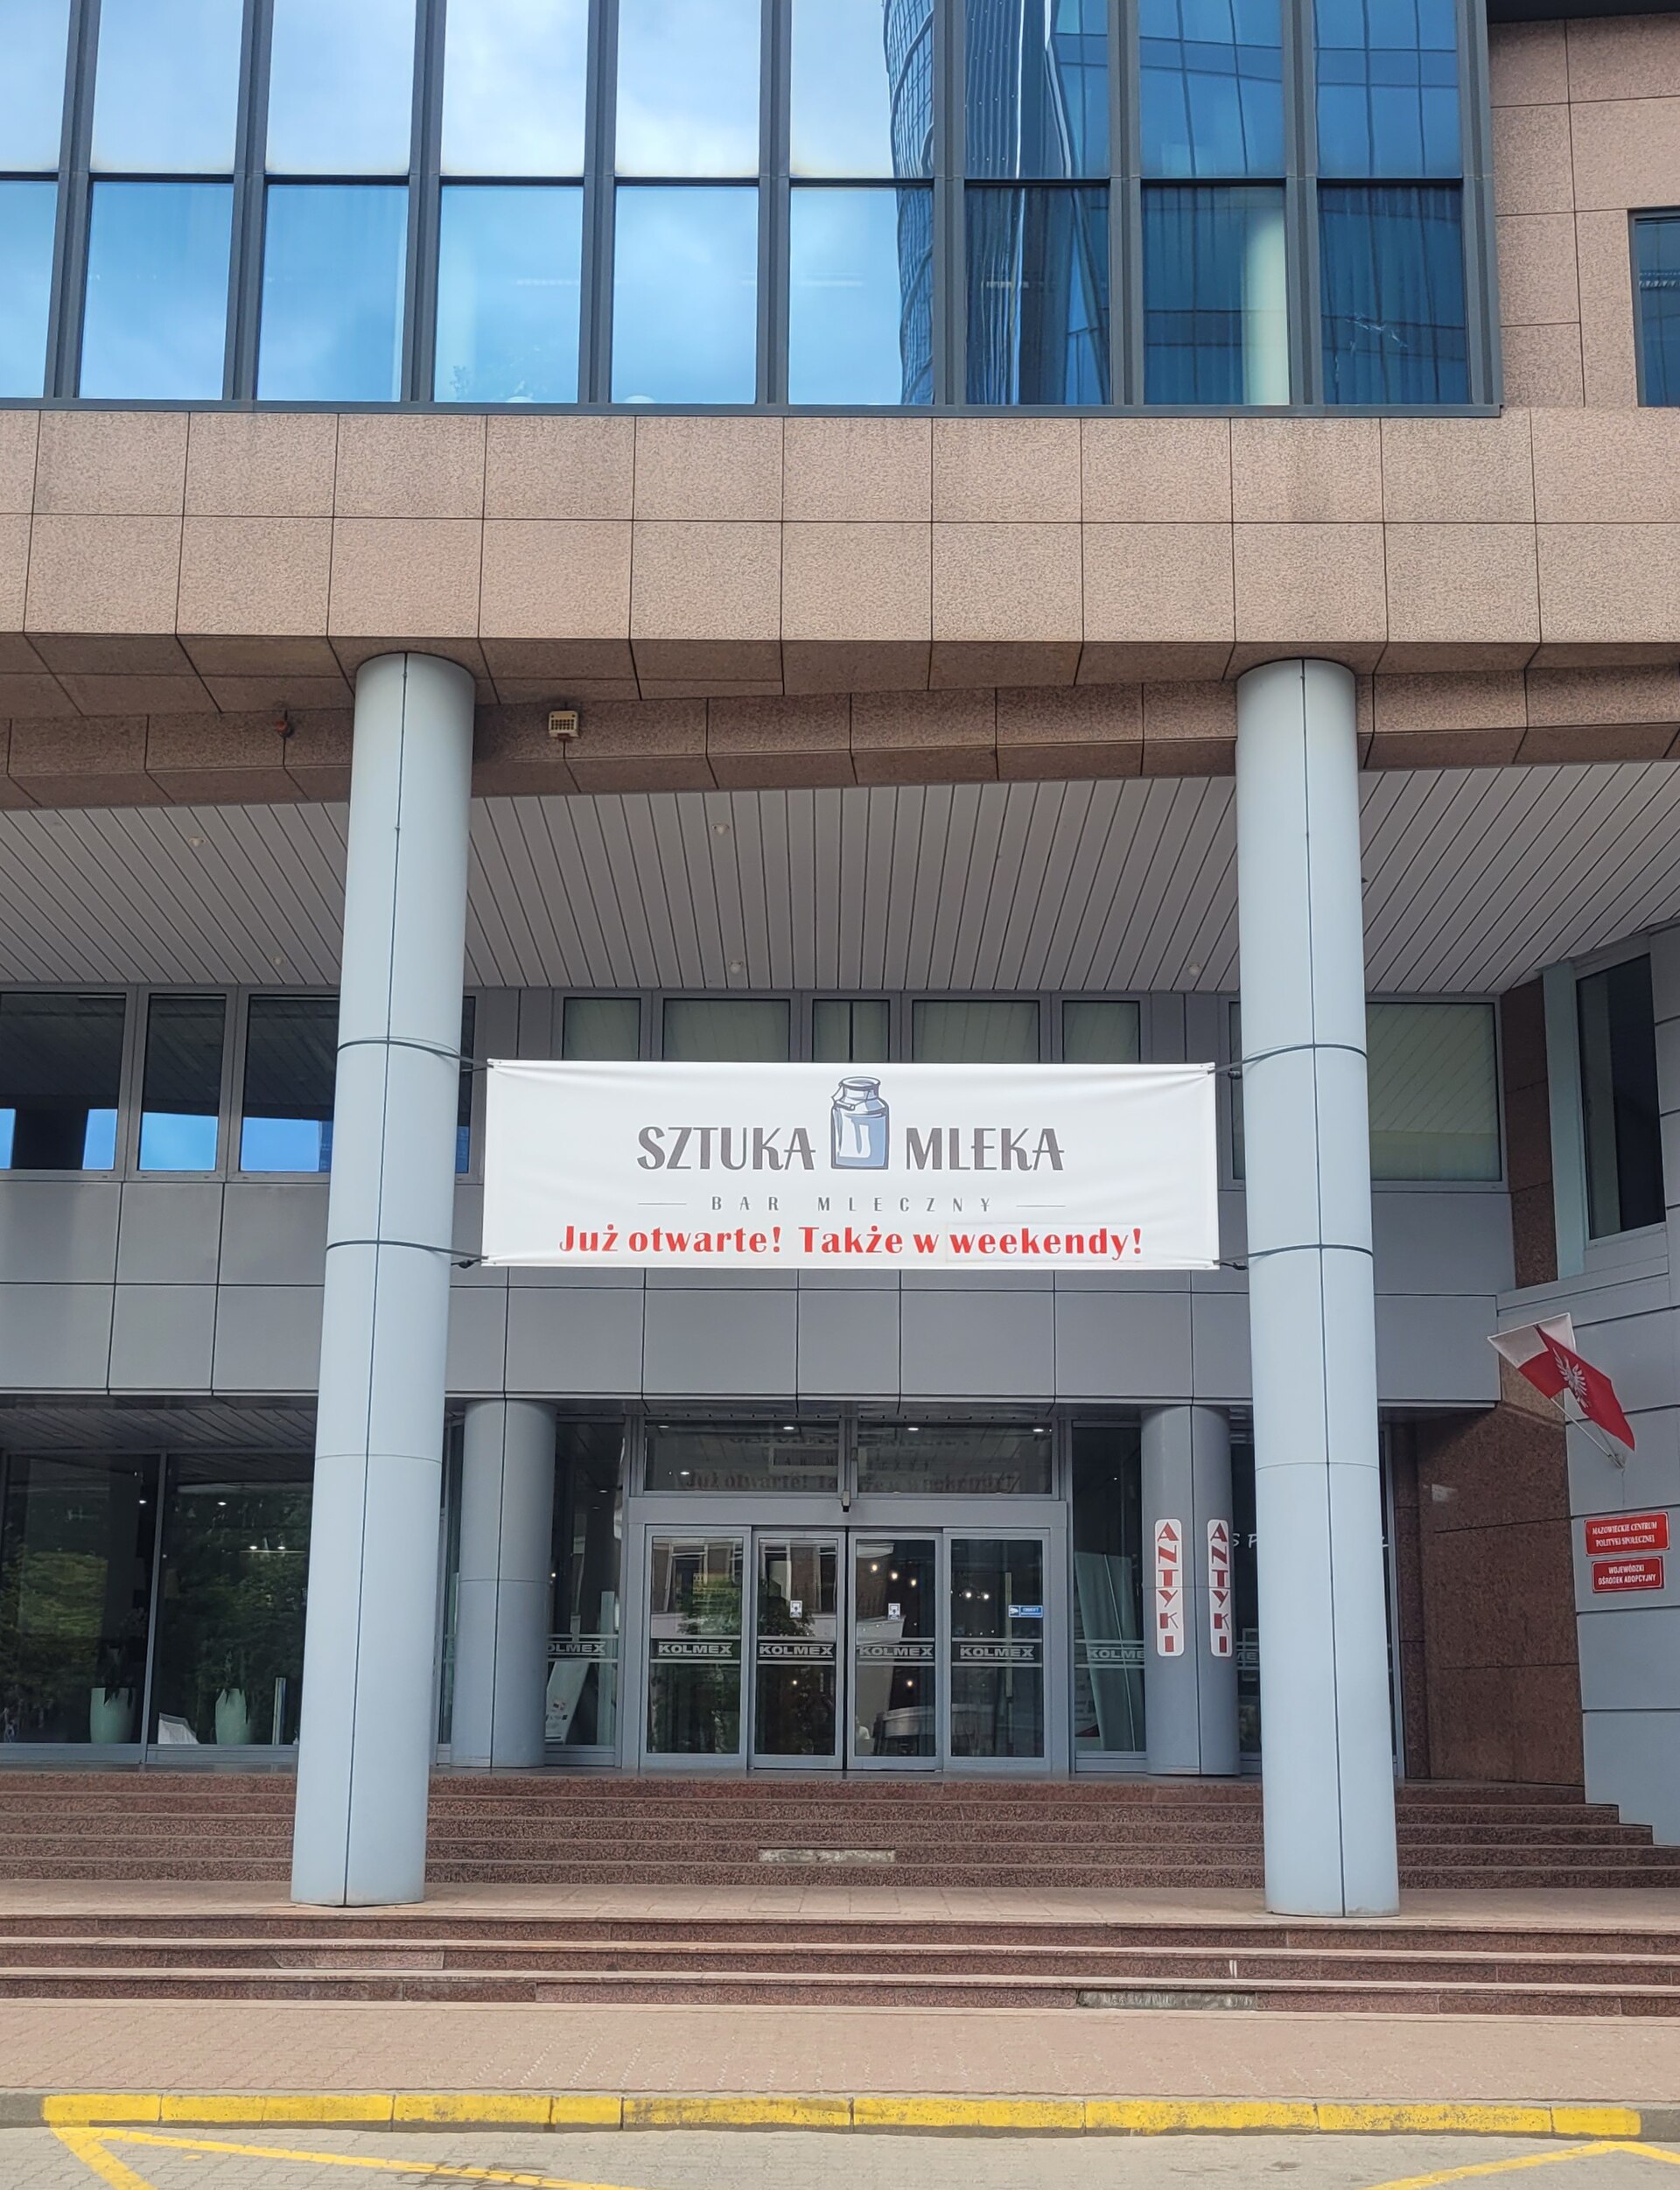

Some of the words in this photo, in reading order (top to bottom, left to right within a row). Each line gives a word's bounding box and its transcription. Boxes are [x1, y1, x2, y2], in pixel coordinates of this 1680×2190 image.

[637, 1126, 816, 1171] SZTUKA
[906, 1128, 1065, 1171] MLEKA
[711, 1196, 780, 1211] BAR
[817, 1197, 992, 1212] MLECZNY
[559, 1224, 618, 1253] Już
[629, 1227, 781, 1253] otwarte!
[799, 1225, 903, 1254] Także
[914, 1234, 940, 1254] w
[949, 1228, 1142, 1260] weekendy!
[1592, 1524, 1630, 1535] MAZOWIECKIE
[1630, 1522, 1657, 1531] CENTRUM
[1595, 1537, 1621, 1547] POLITYKI
[1608, 1564, 1645, 1574] WOJEWÓDZKI
[1598, 1576, 1623, 1585] OŚRODEK
[1624, 1573, 1656, 1584] ADOPCYJNY
[1157, 1522, 1180, 1653] ANTYKI
[1210, 1522, 1229, 1654] ANTYKI
[658, 1644, 732, 1655] KOLMEX
[759, 1645, 833, 1655] KOLMEX
[858, 1646, 933, 1656] KOLMEX
[960, 1647, 1034, 1657] KOLMEX
